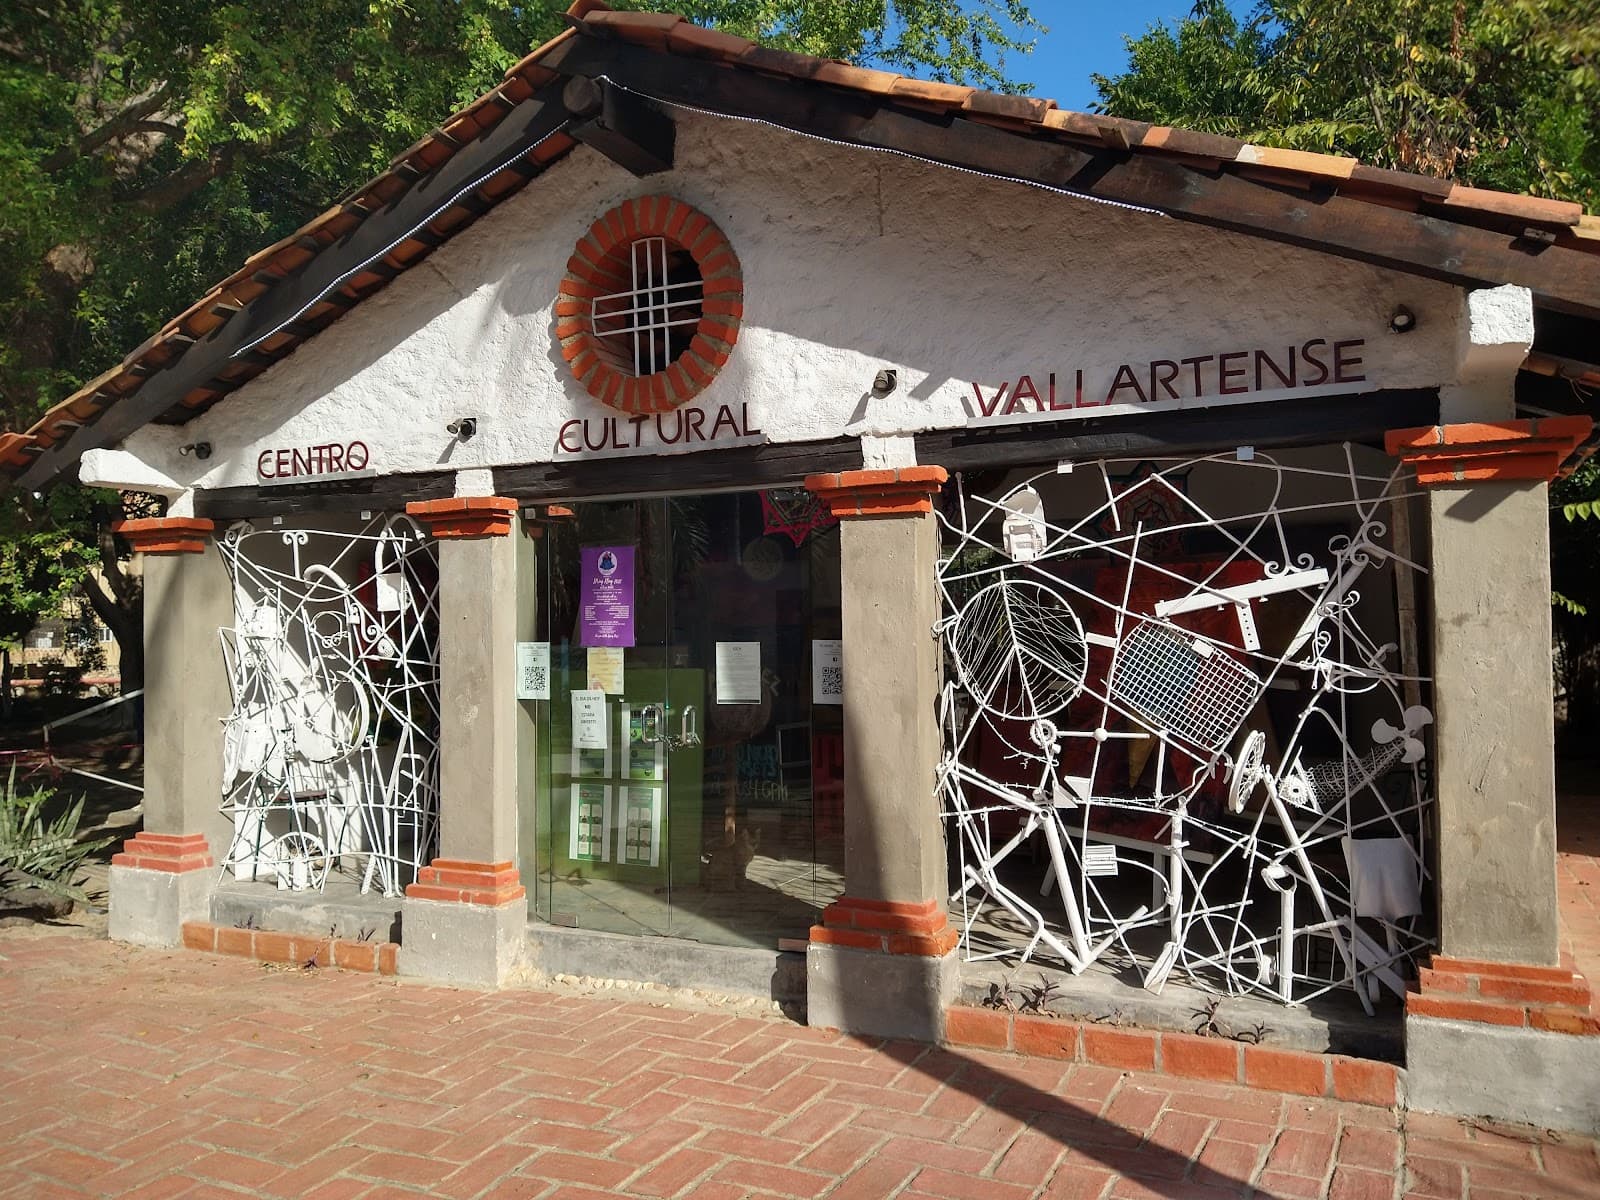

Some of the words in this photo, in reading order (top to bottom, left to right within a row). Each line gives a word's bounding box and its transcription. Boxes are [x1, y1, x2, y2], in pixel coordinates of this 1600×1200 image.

[258, 440, 370, 479] CENTRO
[559, 402, 763, 453] CULTURAL
[972, 338, 1366, 417] VALLARTENSE
